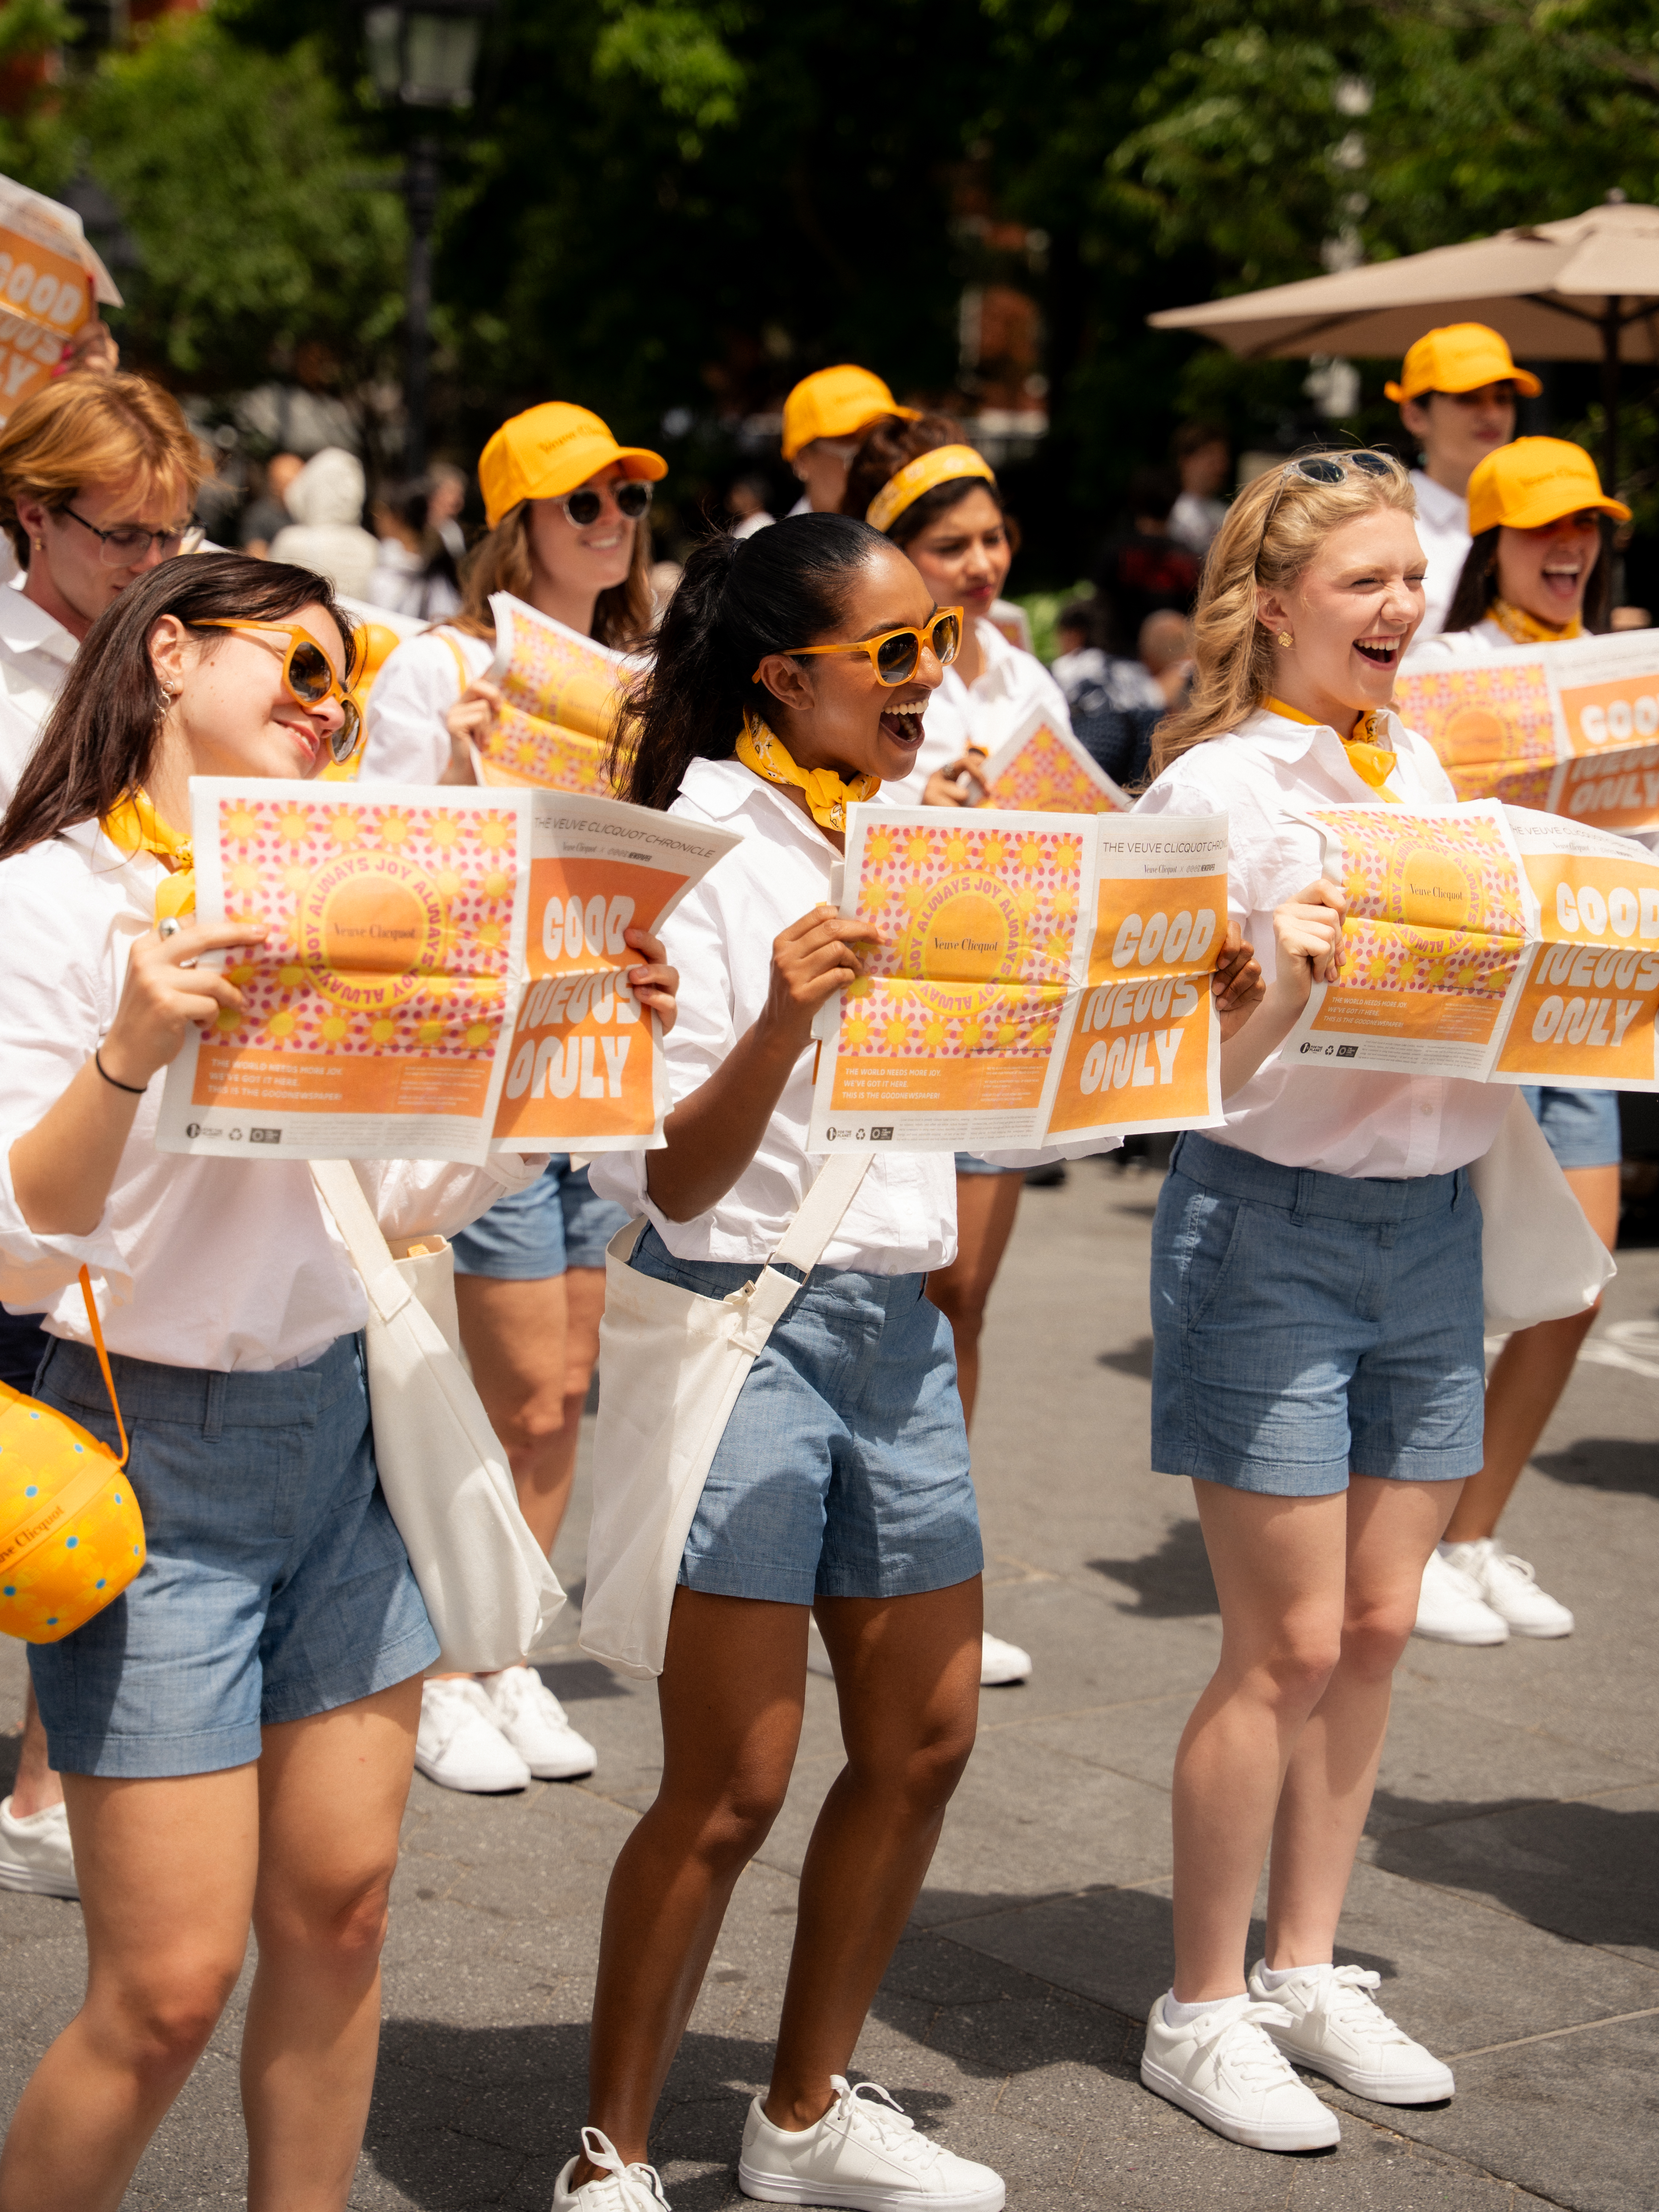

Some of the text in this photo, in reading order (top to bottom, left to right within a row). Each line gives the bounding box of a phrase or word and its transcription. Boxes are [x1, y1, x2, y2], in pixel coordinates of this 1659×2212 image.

[1579, 694, 1659, 744] GOO
[534, 817, 716, 858] THE VEUVE CLICQUOT CHRONICLE
[563, 841, 576, 852] Veuve
[577, 841, 597, 855] Clicquot
[1103, 842, 1124, 852] THE
[1128, 842, 1162, 853] VEUVE
[1164, 842, 1207, 853] CLICQUOT
[1525, 826, 1562, 835] VEUVE
[309, 857, 369, 917] ALWAYS
[375, 858, 413, 880] JOY
[1144, 864, 1158, 873] Veuve
[1159, 864, 1177, 875] Clicquot
[1410, 883, 1463, 901] Veuve Clicquot
[1392, 840, 1480, 953] ALWAYS JOY ALWAYS JOY ALWAYS JOY
[1556, 881, 1659, 939] GOOD
[306, 923, 322, 961] JOY
[334, 922, 416, 942] Veuve Clicquot
[412, 881, 441, 967] ALWAYS
[542, 895, 635, 960] GOOD
[909, 877, 1019, 1011] ALWAYS JOY ALWAYS JOY ALWAYS JOY
[934, 937, 998, 954] Veuve Clicquot
[1112, 908, 1216, 968] GOOD
[1535, 939, 1659, 991] NEWS
[517, 963, 643, 1032] NEWS
[1080, 970, 1209, 1034] NEWS
[1355, 1018, 1404, 1028] GOODNEWSPAPER!
[1532, 995, 1644, 1047] ONLY
[506, 1036, 631, 1100] ONLY
[1080, 1029, 1184, 1095] ONLY
[15, 1505, 64, 1547] Clicquot
